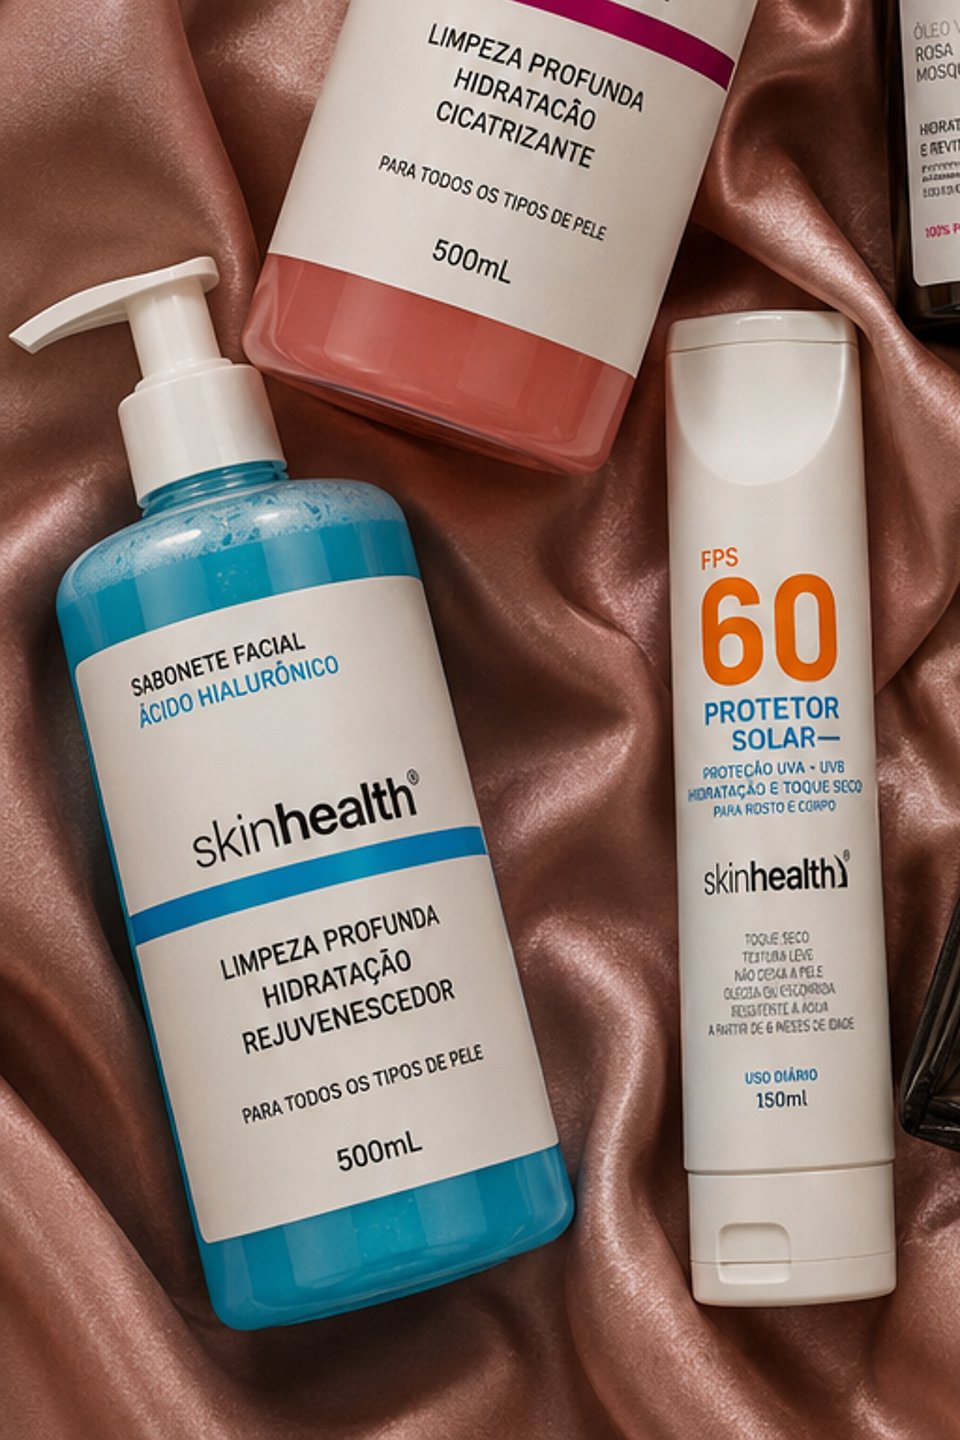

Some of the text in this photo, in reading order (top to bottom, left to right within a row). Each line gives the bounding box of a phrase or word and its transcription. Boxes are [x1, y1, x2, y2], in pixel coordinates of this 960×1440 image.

[428, 22, 645, 112] LIMPEZA PROFUNDA
[915, 43, 953, 62] ROSA
[436, 100, 595, 169] CICATRIZANTE
[378, 155, 607, 241] PARA TODOS OS TIPOS DE PELE
[432, 238, 512, 285] 500mL
[701, 546, 739, 570] FPS
[701, 573, 838, 686] 60
[131, 632, 306, 697] SABONETE FACIAL
[139, 655, 339, 729] ÁCIDO HIALURÔNICO
[704, 696, 840, 726] PROTETOR
[770, 781, 778, 794] E
[783, 780, 829, 794] TOQUE
[777, 761, 805, 775] UVA
[220, 905, 440, 980] LIMPEZA PROFUNDA
[262, 948, 412, 1008] HIDRATAÇÃO
[242, 978, 455, 1054] REJUVENESCEDOR
[242, 1044, 484, 1124] PARA TODOS OS TIPOS DE PELE
[745, 1071, 771, 1084] USO
[337, 1130, 423, 1172] 500mL
